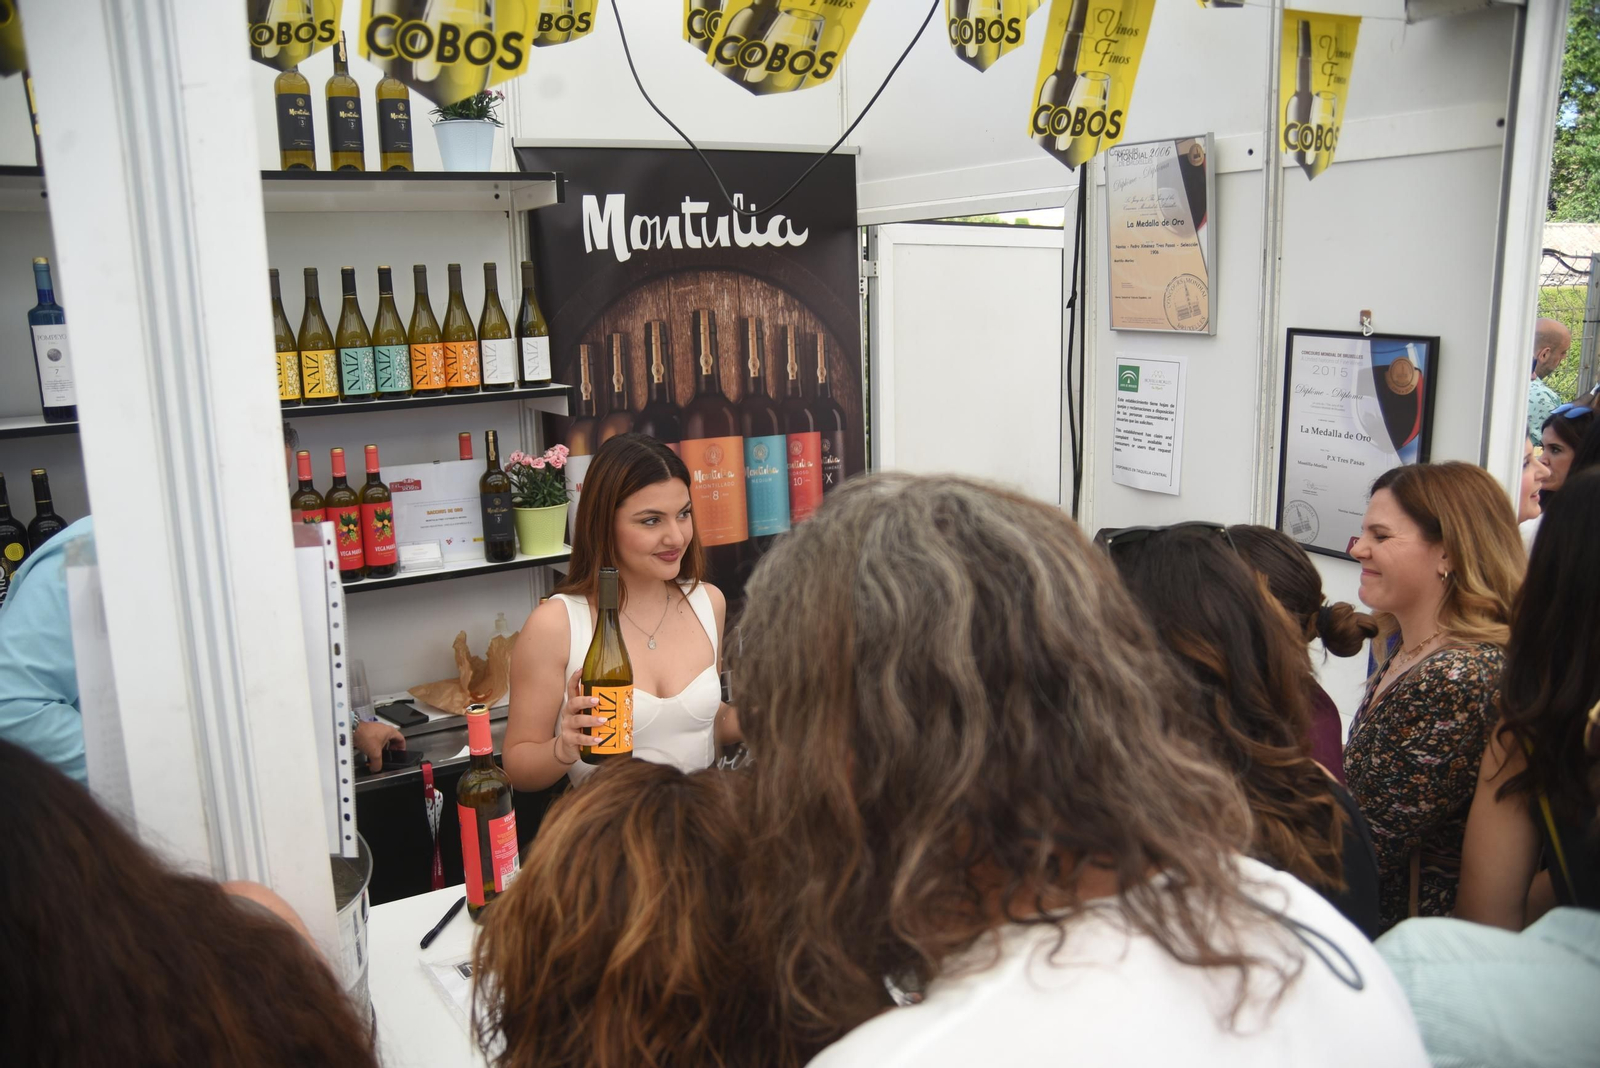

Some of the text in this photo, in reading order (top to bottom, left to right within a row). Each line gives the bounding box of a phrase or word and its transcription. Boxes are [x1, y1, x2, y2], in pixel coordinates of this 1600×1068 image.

[250, 19, 335, 46] OBOS
[538, 11, 592, 33] BOS
[949, 17, 1021, 45] COBOS
[1097, 8, 1140, 37] Vinos
[366, 15, 525, 71] COBOS
[714, 35, 838, 79] COBOS
[1094, 38, 1132, 67] Finos
[1032, 104, 1123, 140] COBOS
[1283, 123, 1341, 152] COBOS
[1116, 146, 1171, 162] MONDIAL 2006
[582, 193, 809, 263] Montulia
[1136, 219, 1160, 228] Medalla
[1161, 218, 1169, 226] de
[1171, 218, 1185, 226] Oro
[37, 333, 68, 342] POMPEYO
[303, 353, 322, 394] NAÍZ
[343, 351, 361, 391] NAÍZ
[375, 348, 393, 388] NAÍZ
[411, 346, 429, 386] NAÍZ
[444, 345, 459, 383] NAÍZ
[1312, 364, 1348, 378] 2015
[1331, 387, 1363, 401] Diploma
[1300, 425, 1372, 443] La Medalla de Oro
[1338, 456, 1349, 464] Tres
[1349, 458, 1365, 466] Pasas
[695, 481, 735, 490] AMONTILLADO
[712, 490, 719, 500] 8
[793, 476, 803, 486] 10
[593, 691, 617, 749] NAÍZ
